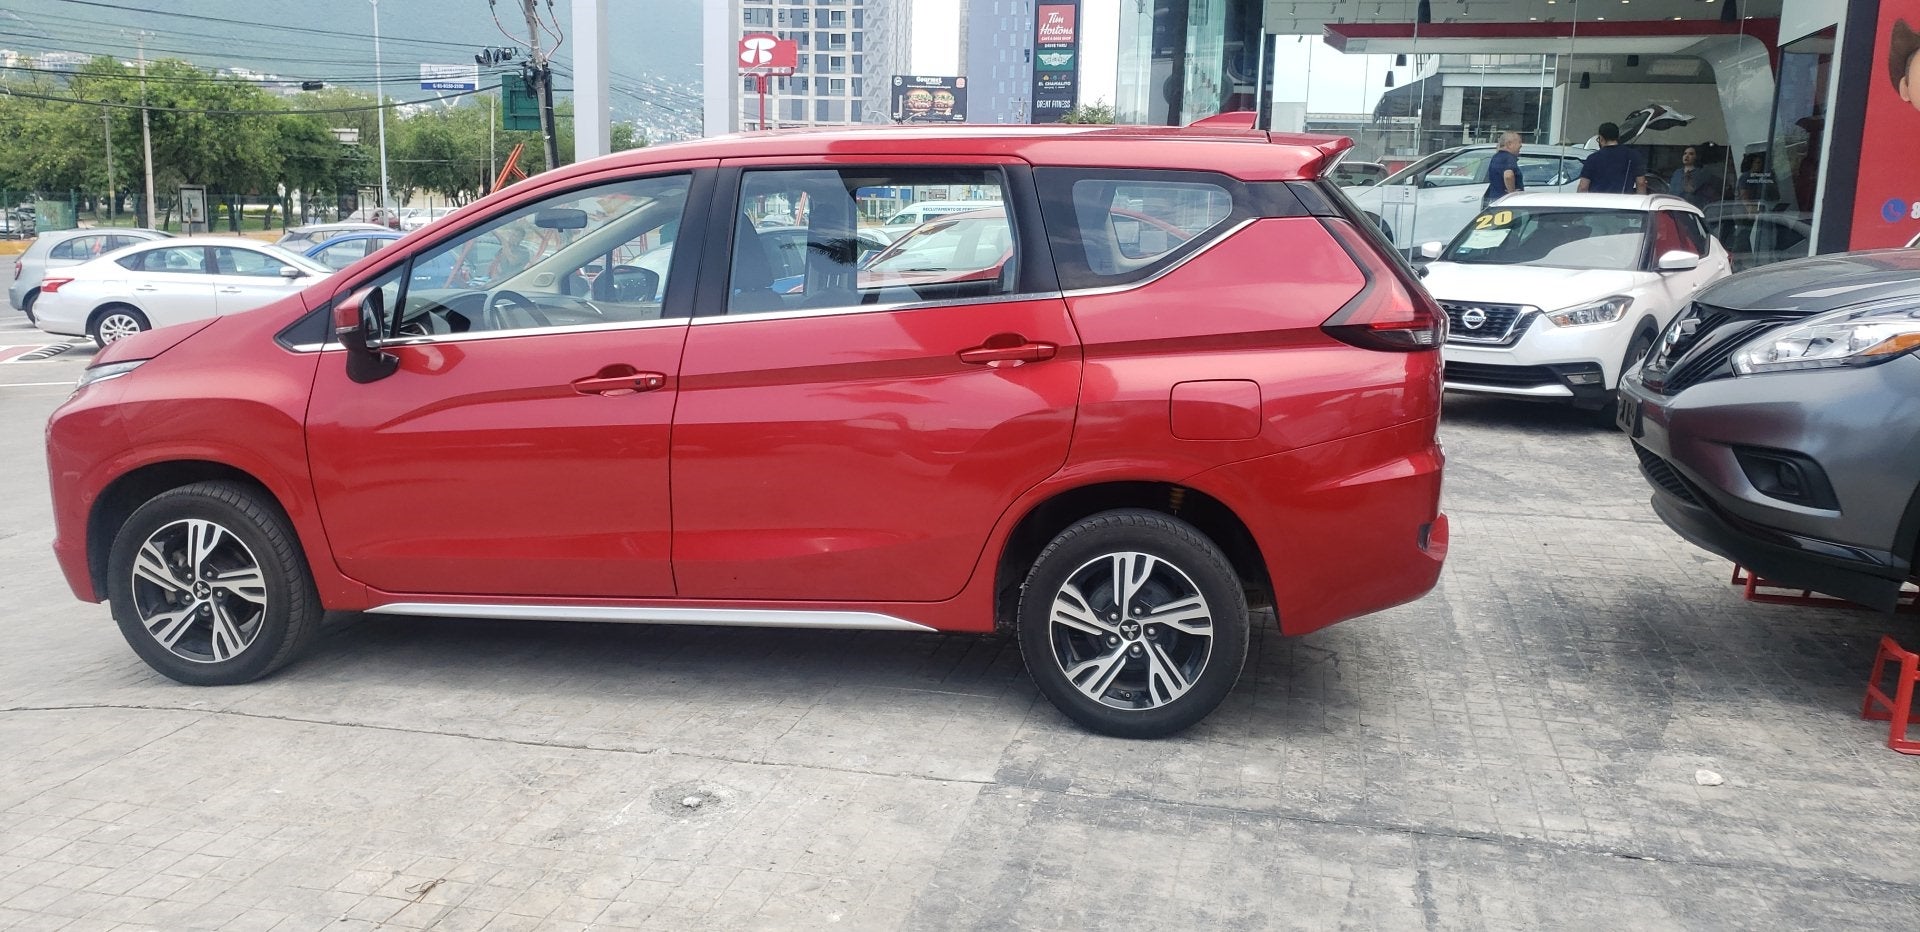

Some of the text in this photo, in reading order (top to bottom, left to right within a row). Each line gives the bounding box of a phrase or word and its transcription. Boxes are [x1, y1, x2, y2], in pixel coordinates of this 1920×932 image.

[1048, 12, 1064, 23] Tim
[1040, 23, 1073, 35] Hortons
[1052, 100, 1071, 108] FITNESS
[1475, 211, 1512, 230] 20
